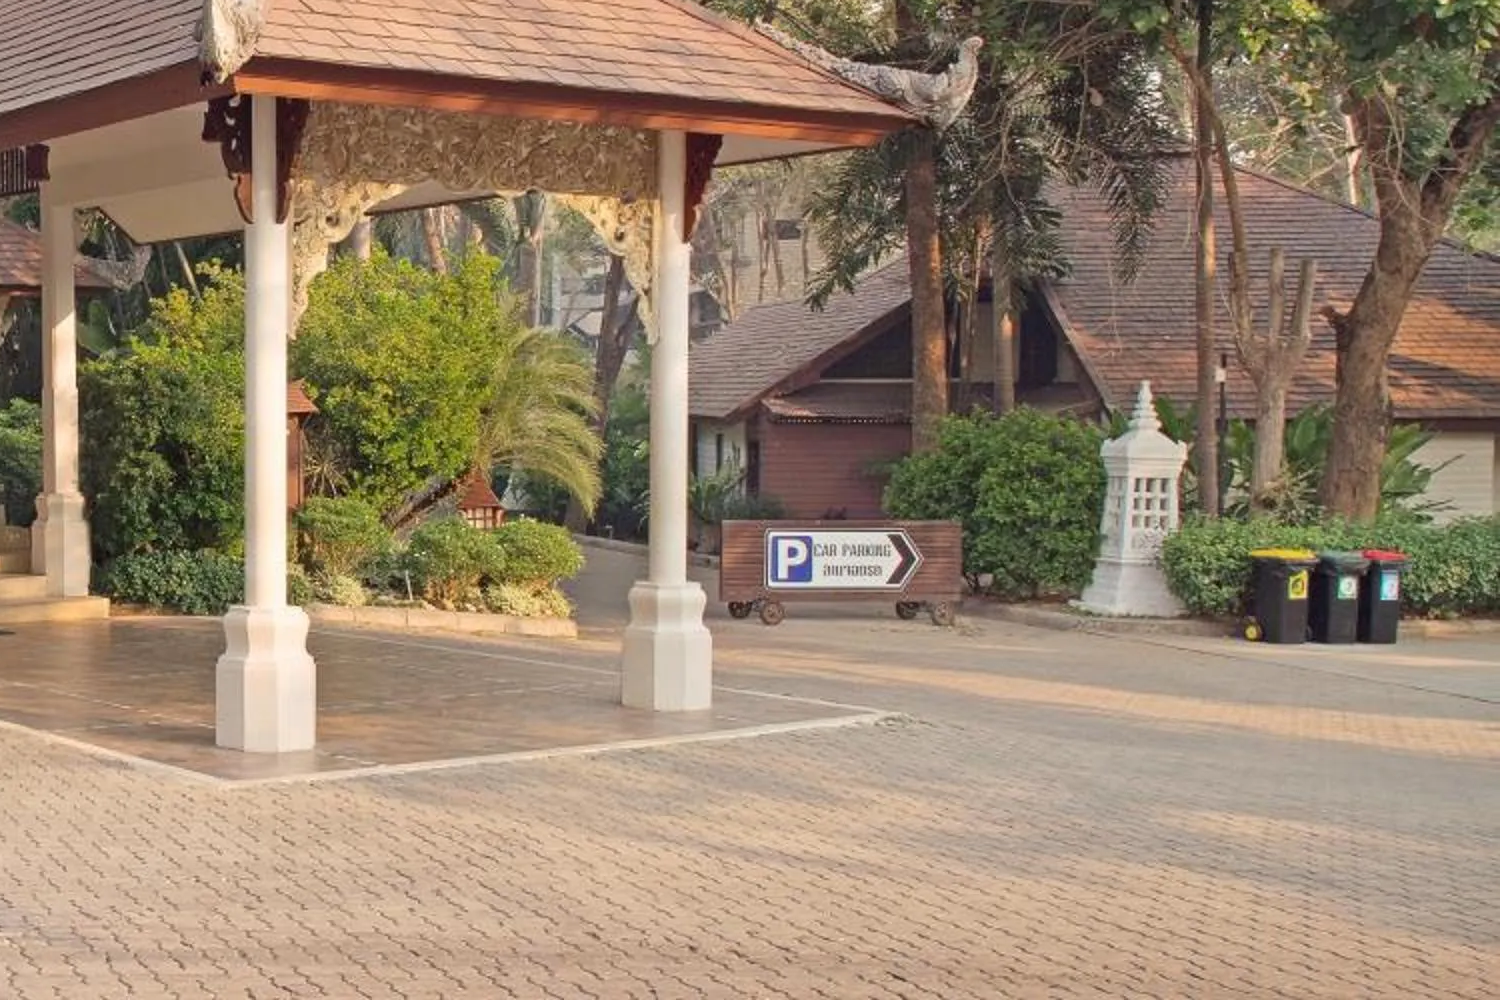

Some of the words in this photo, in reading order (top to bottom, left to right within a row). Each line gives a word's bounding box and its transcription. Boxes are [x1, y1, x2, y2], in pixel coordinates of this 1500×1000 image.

[777, 539, 808, 580] P
[813, 543, 837, 557] CAR
[842, 543, 891, 557] PARKING
